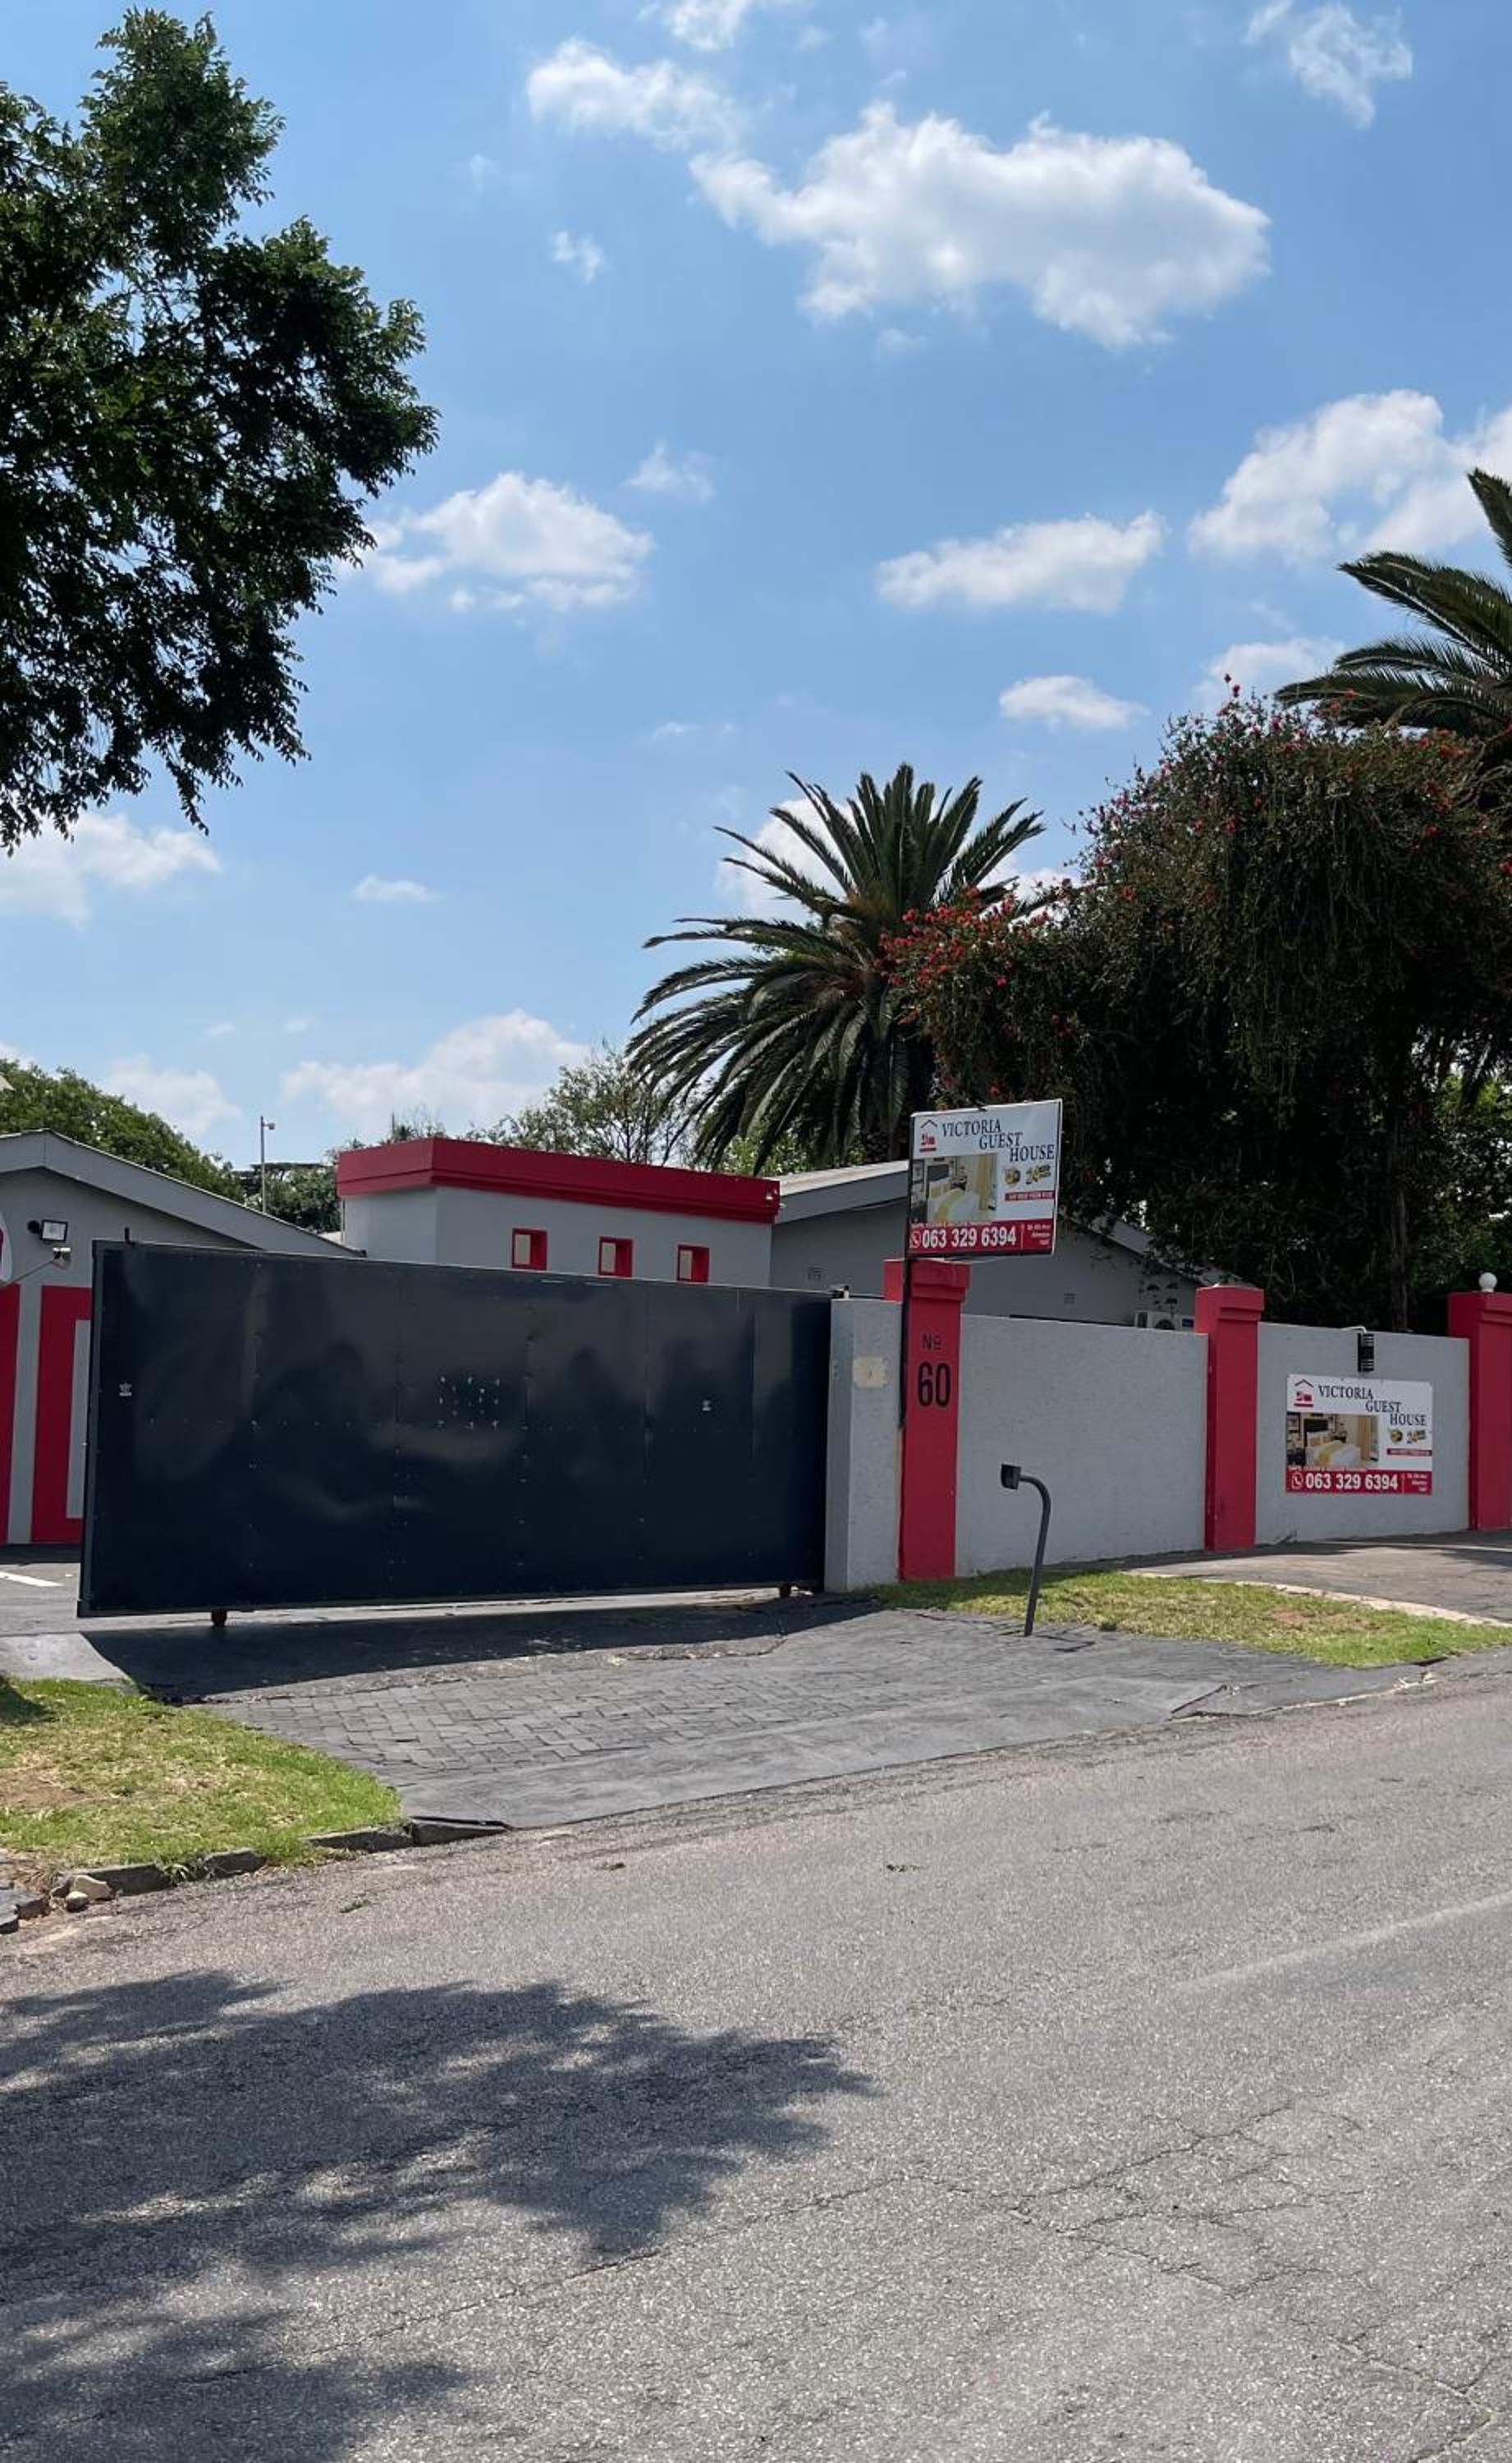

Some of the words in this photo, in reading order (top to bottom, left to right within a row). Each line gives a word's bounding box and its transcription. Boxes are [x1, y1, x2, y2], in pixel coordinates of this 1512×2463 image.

[942, 1119, 1001, 1137] VICTORIA
[979, 1132, 1023, 1149] GUEST
[1010, 1144, 1055, 1162] HOUSE
[922, 1230, 946, 1248] 063
[951, 1228, 977, 1247] 329
[981, 1226, 1016, 1246] 6394
[919, 1361, 951, 1407] 60
[1318, 1385, 1373, 1399] VICTORIA
[1365, 1401, 1401, 1413] GUEST
[1390, 1414, 1427, 1425] HOUSE
[1306, 1473, 1331, 1489] 063
[1336, 1474, 1361, 1489] 329
[1365, 1474, 1398, 1490] 6394
